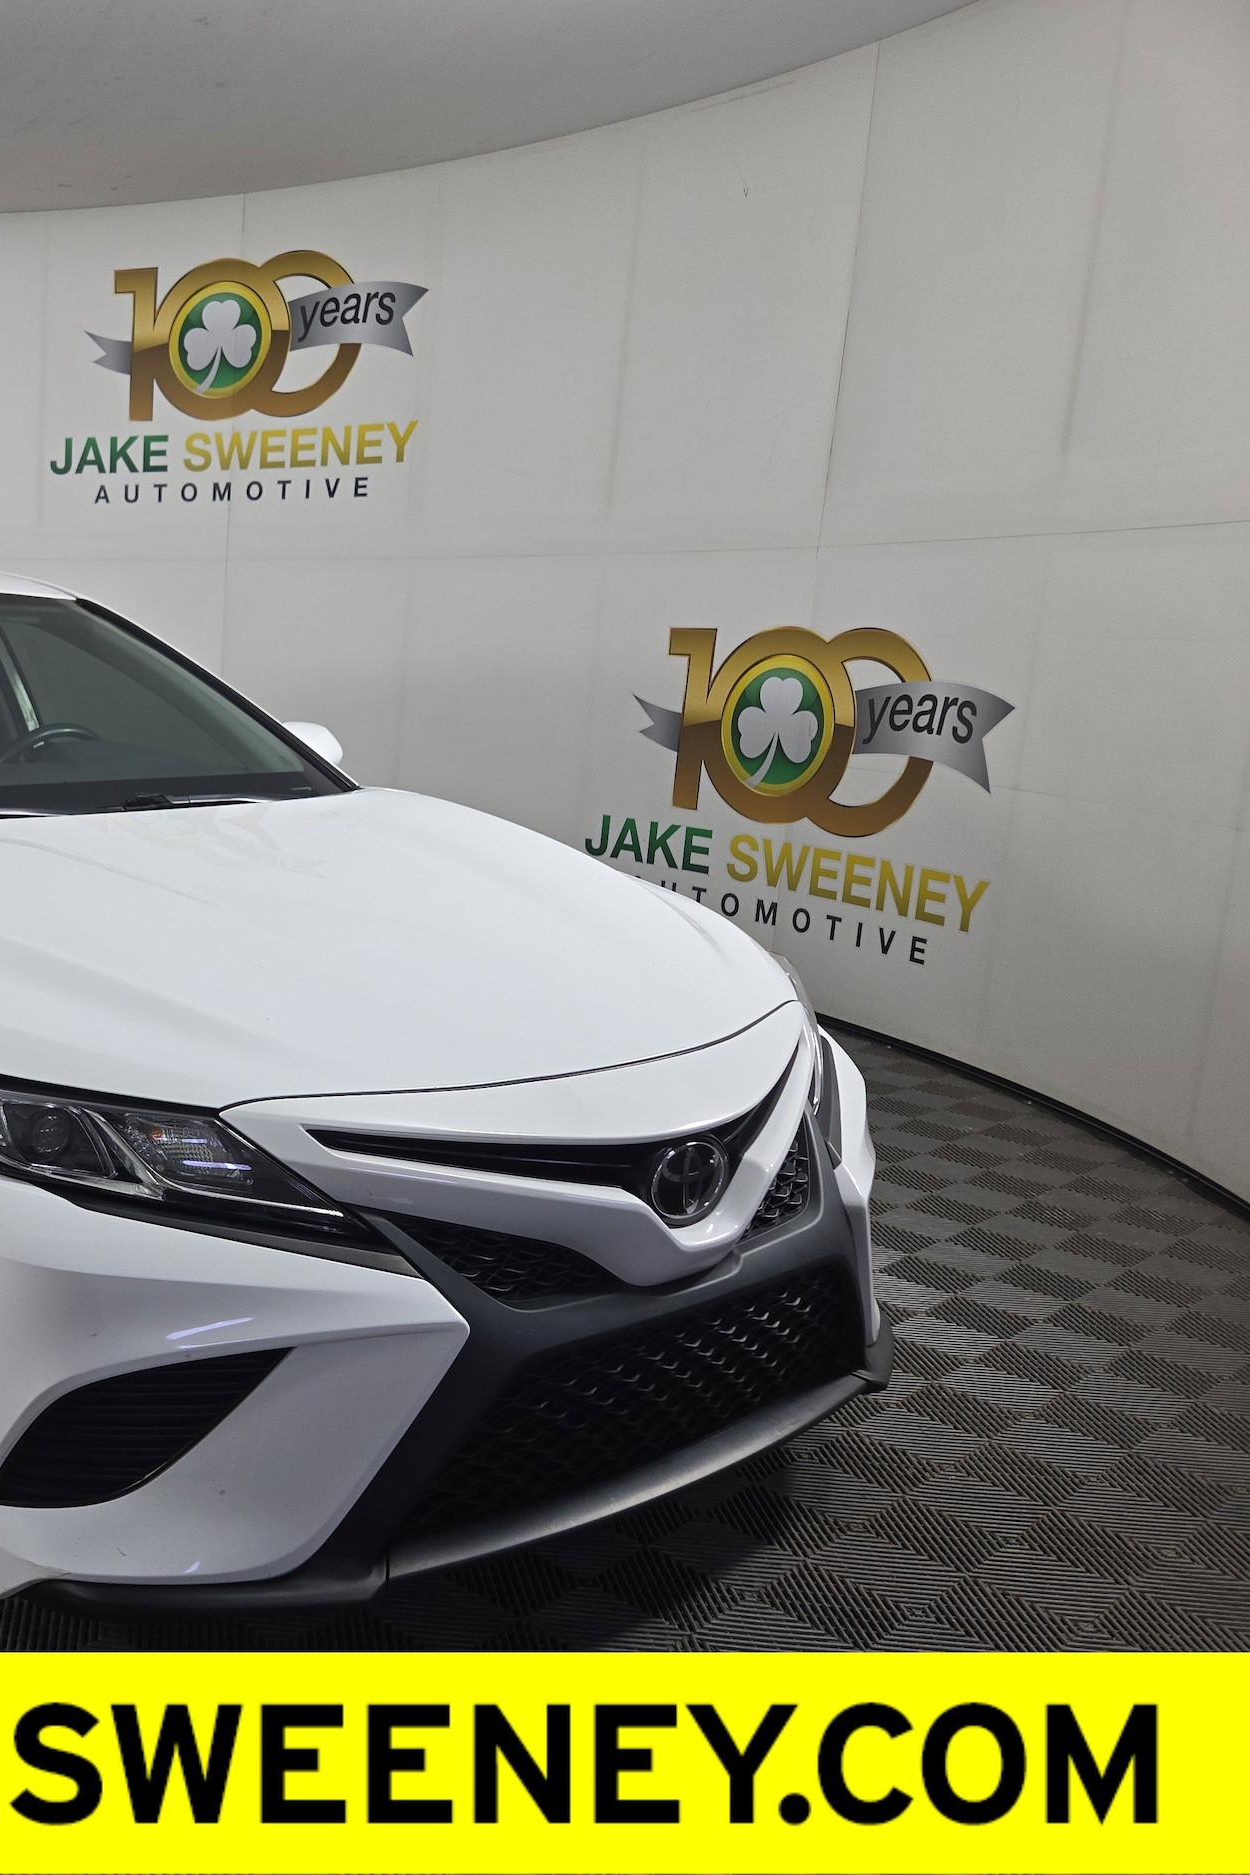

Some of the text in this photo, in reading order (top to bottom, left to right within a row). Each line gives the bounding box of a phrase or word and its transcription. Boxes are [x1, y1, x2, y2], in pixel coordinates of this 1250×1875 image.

[114, 250, 397, 422] 100 years
[50, 420, 420, 475] JAKE SWEENEY
[94, 476, 370, 504] AUTOMOTIVE
[668, 626, 978, 838] 100 years
[584, 814, 991, 934] JAKE SWEENEY
